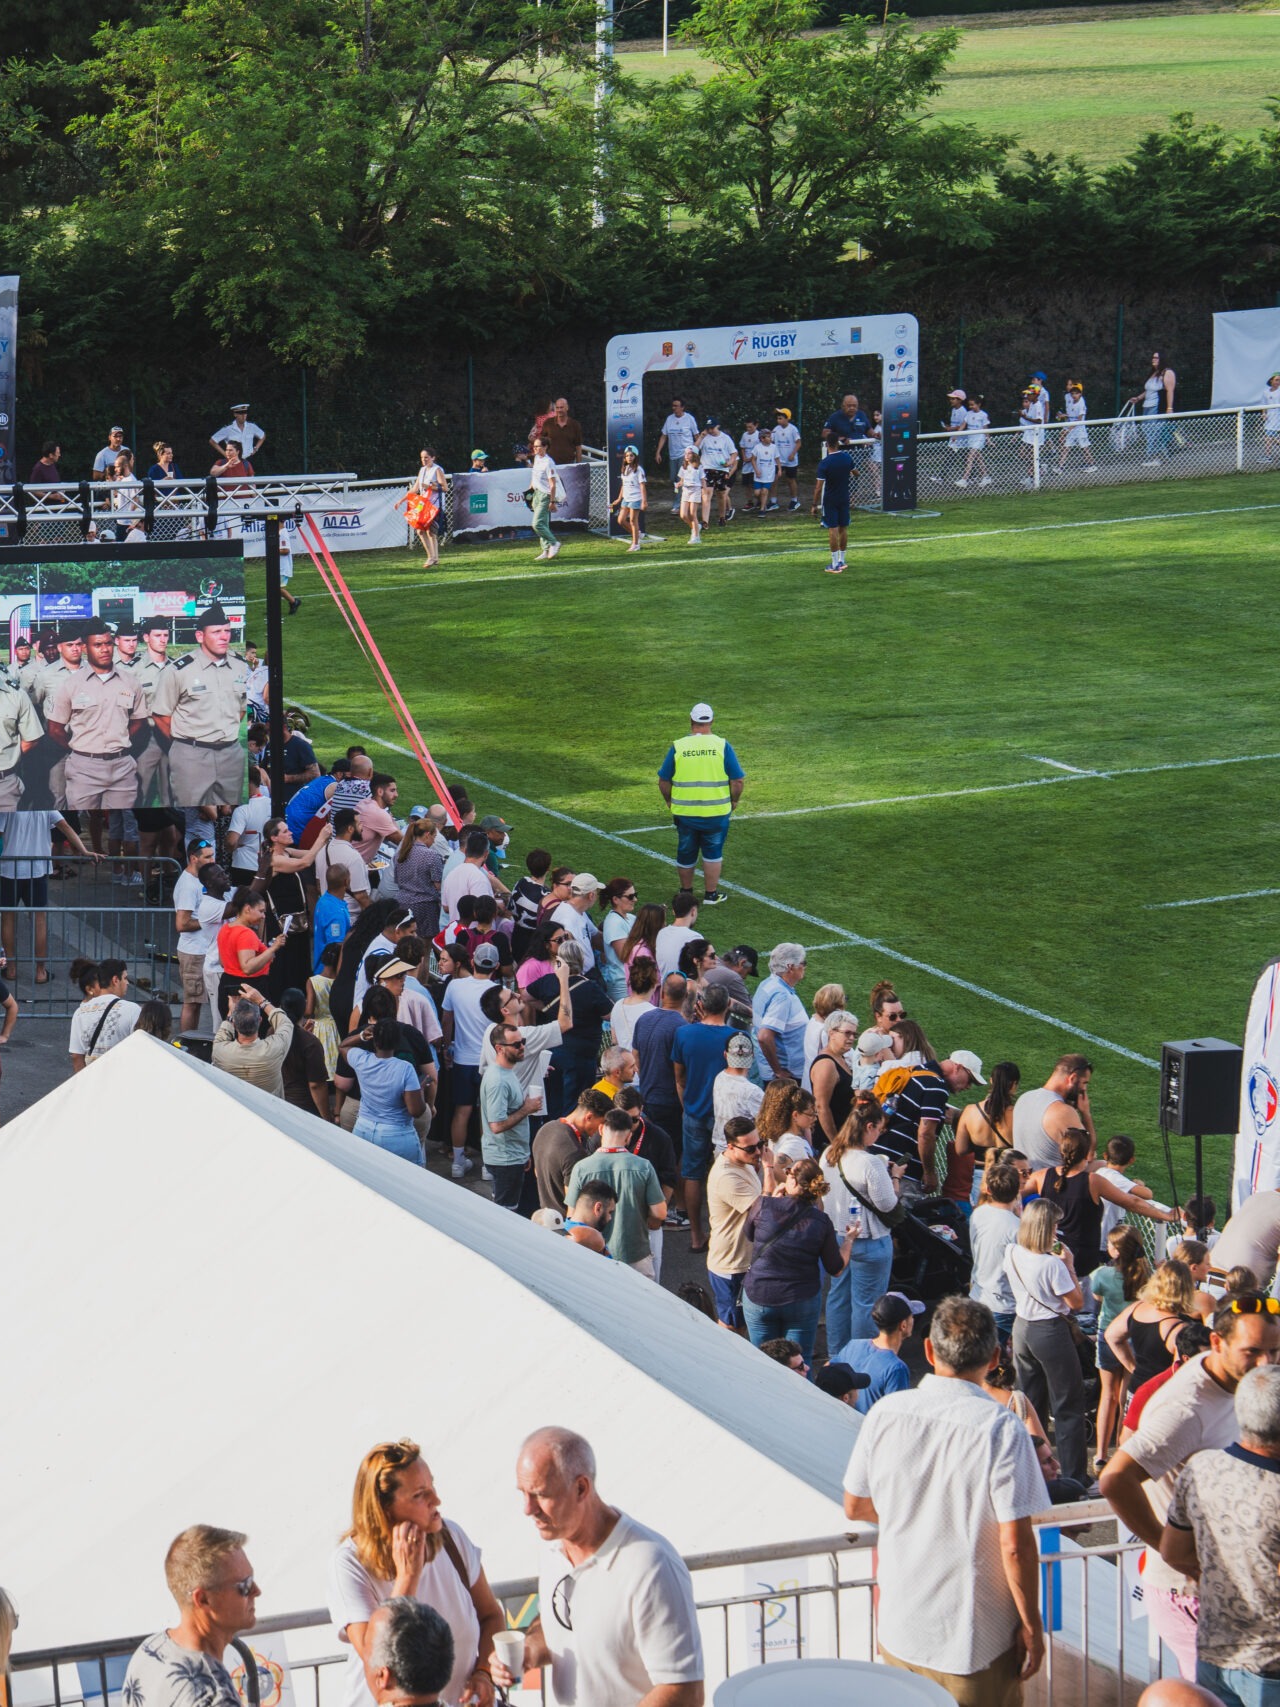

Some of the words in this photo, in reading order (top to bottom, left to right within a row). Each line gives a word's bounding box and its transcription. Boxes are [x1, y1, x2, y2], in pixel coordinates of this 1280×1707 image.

[752, 334, 797, 350] RUGBY
[773, 349, 790, 357] CISM
[322, 514, 361, 527] MAA
